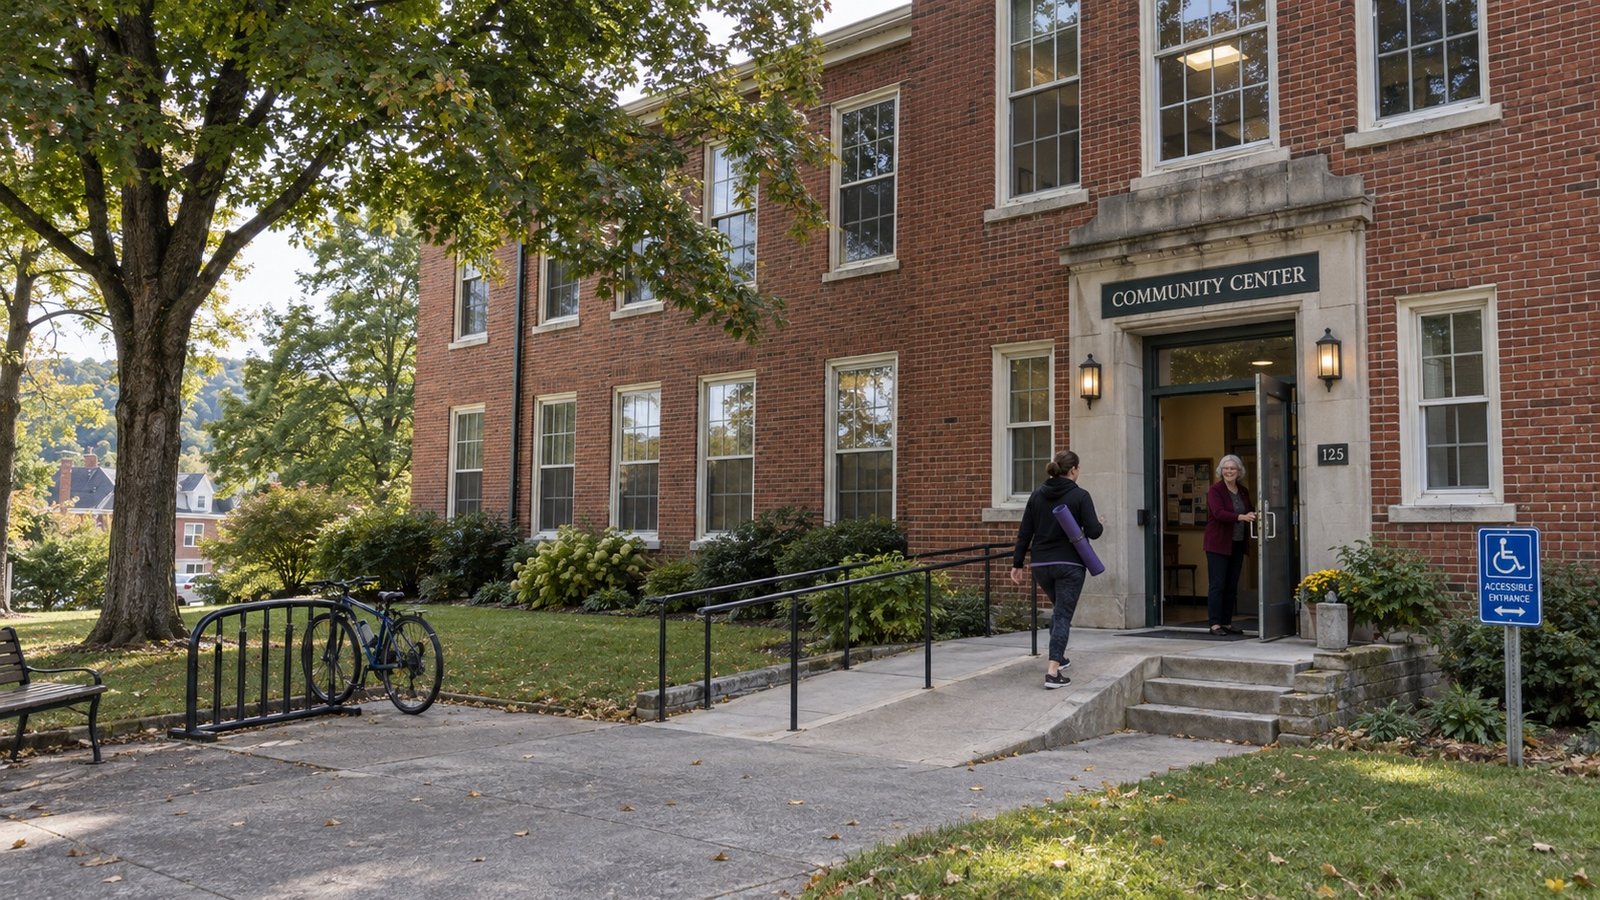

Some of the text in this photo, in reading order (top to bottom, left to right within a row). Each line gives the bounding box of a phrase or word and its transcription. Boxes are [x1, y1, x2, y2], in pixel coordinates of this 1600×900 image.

[1112, 266, 1306, 307] COMMUNITY CENTER
[1322, 448, 1344, 461] 125
[1484, 582, 1534, 592] ACCESSIBLE
[1488, 593, 1531, 603] ENTRANCE
